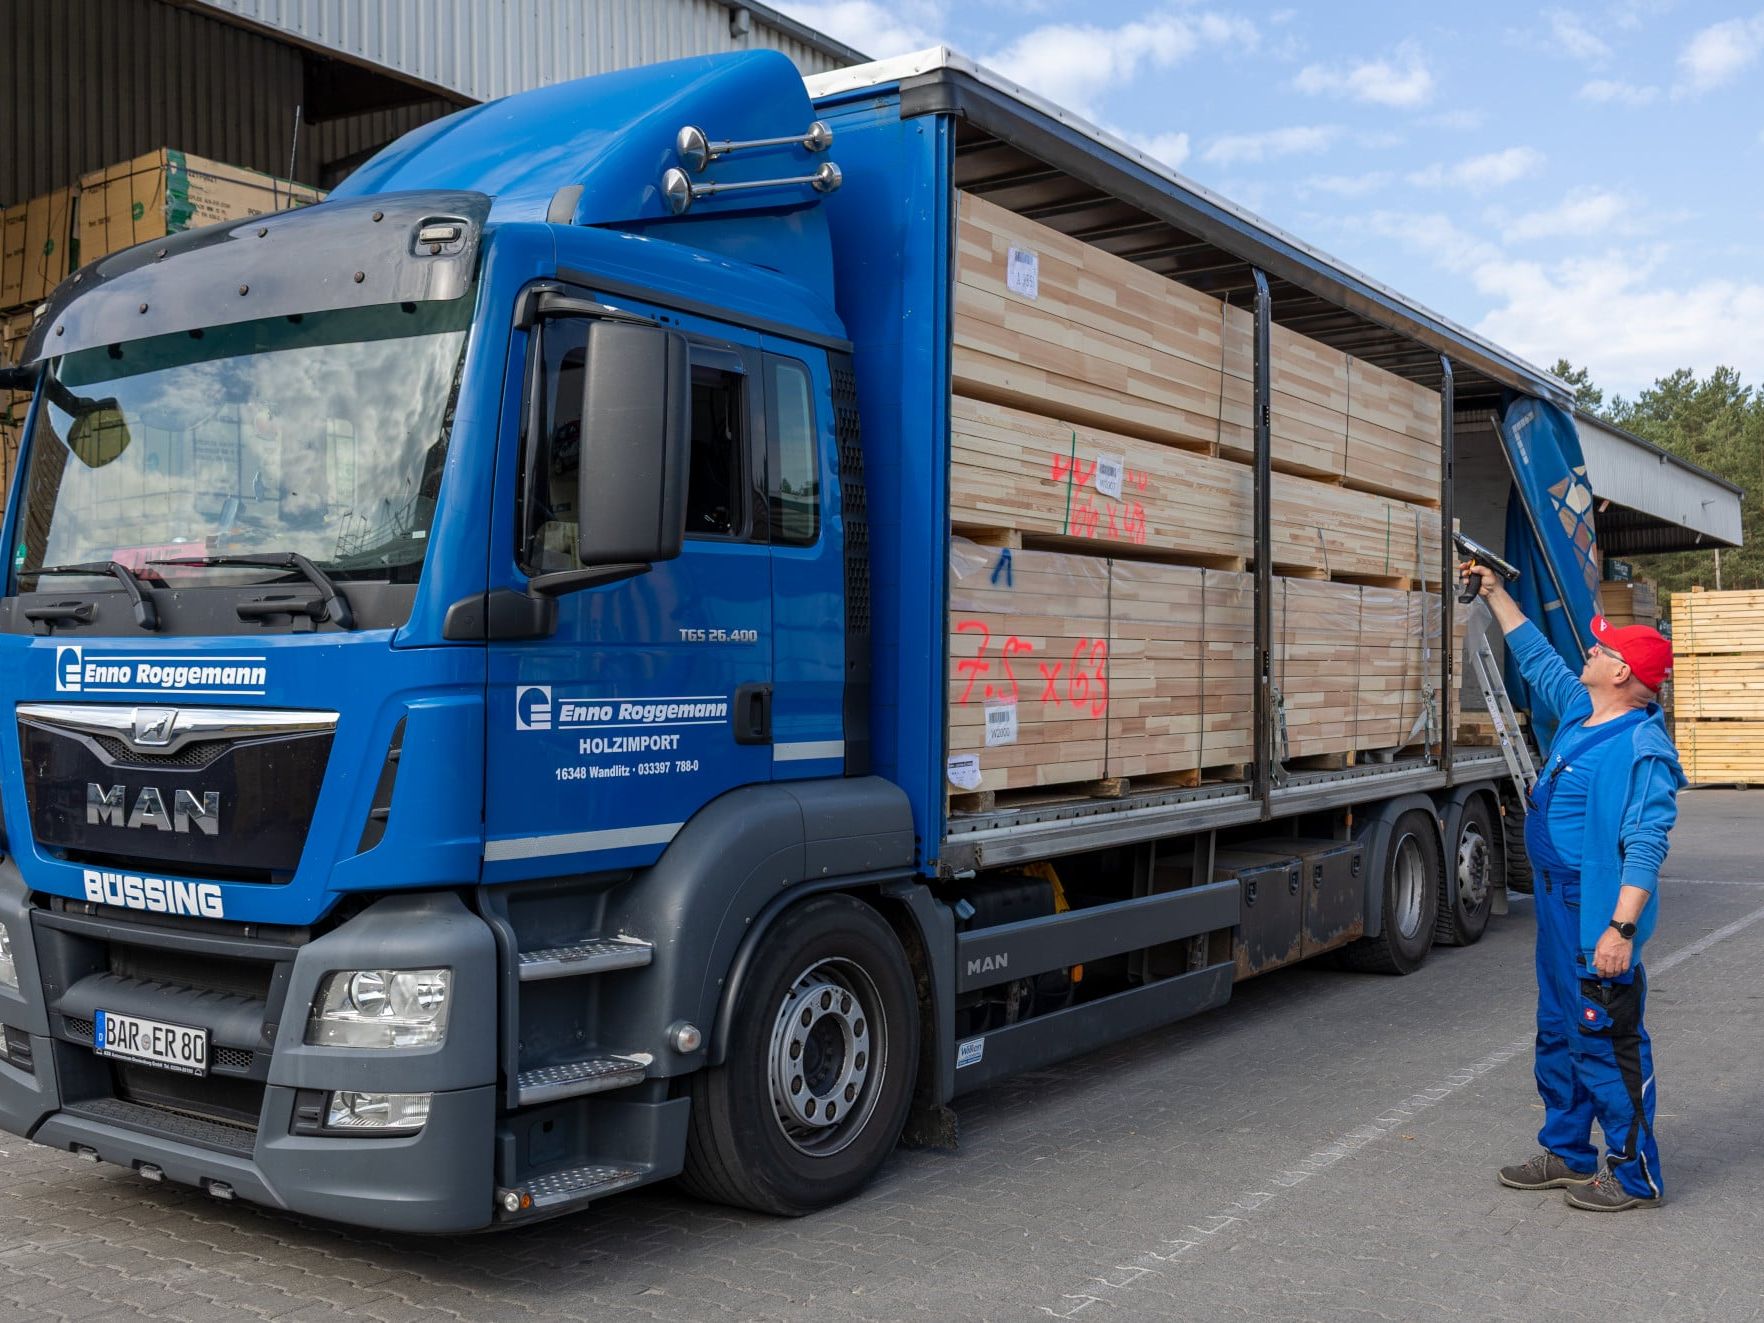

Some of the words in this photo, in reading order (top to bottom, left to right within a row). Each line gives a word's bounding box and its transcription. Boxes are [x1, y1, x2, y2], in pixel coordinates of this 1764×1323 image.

[679, 629, 705, 642] TGS
[708, 629, 758, 642] 26.400
[84, 664, 132, 684] Enno
[136, 664, 267, 688] Roggemann
[1068, 637, 1107, 719] 63
[559, 704, 613, 722] Enno
[618, 702, 728, 722] Roggemann
[579, 735, 680, 754] HOLZIMPORT
[555, 767, 587, 781] 16348
[589, 764, 630, 777] Wandlitz
[638, 761, 671, 775] 033397
[675, 760, 699, 772] 788-0
[87, 783, 220, 835] MAN
[83, 870, 224, 918] BÜSSING
[967, 952, 1008, 976] MAN
[98, 1033, 104, 1042] D
[106, 1017, 140, 1052] BAR
[153, 1026, 177, 1059] ER
[181, 1032, 205, 1064] 80
